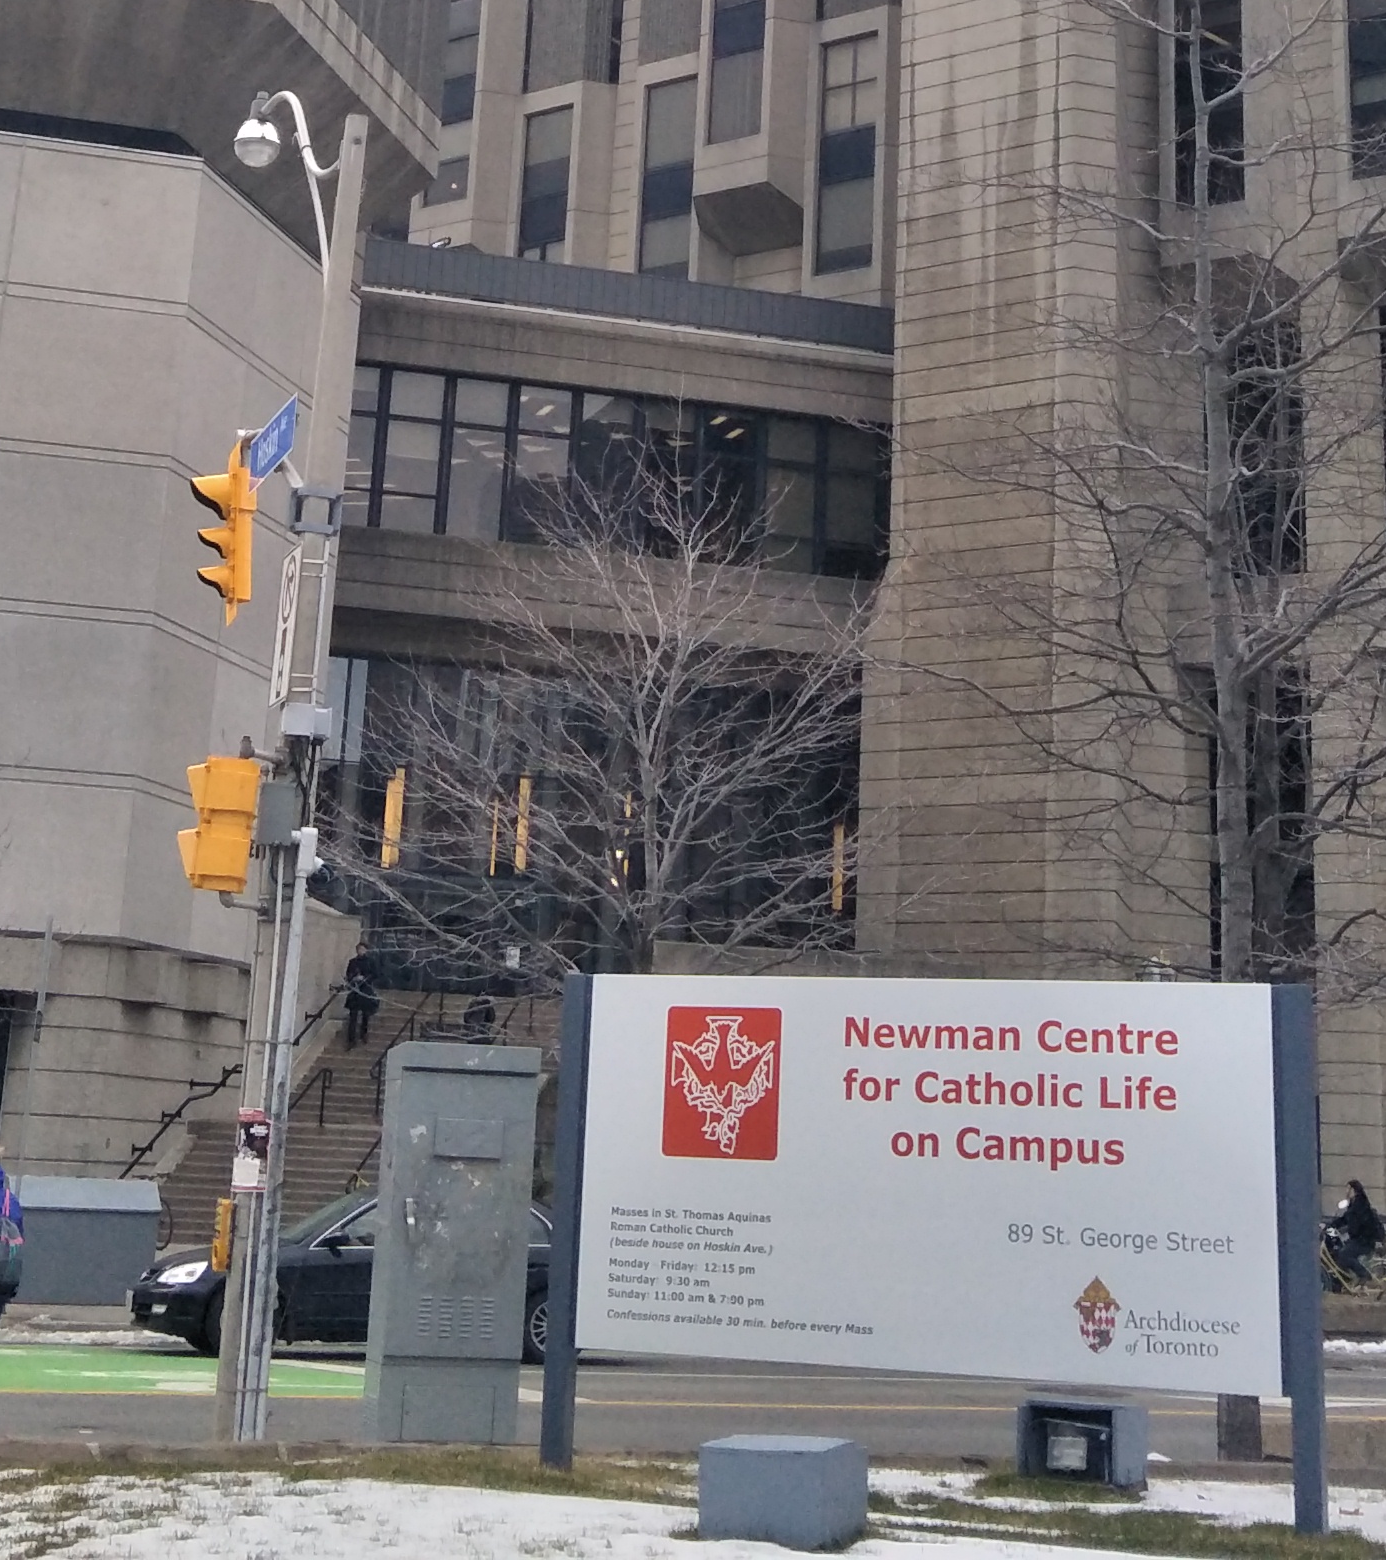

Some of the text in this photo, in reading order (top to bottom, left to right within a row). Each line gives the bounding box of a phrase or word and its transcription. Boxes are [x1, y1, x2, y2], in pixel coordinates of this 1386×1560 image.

[844, 1016, 1179, 1056] Newman Centre
[843, 1068, 1178, 1111] for Catholic Life
[891, 1127, 1126, 1171] on Campus
[611, 1206, 649, 1218] Masses
[652, 1208, 662, 1218] in
[682, 1209, 725, 1221] Thomas
[727, 1211, 772, 1223] Aquinas
[610, 1221, 734, 1237] Roman Catholic Church
[1007, 1223, 1235, 1254] 89 St. George Street
[609, 1236, 774, 1256] (beside house on Hoskin Ave.)
[608, 1257, 650, 1271] Monday
[704, 1262, 735, 1274] 12:15
[738, 1265, 756, 1276] pm
[665, 1275, 691, 1287] 9:30
[693, 1278, 710, 1287] am
[607, 1288, 765, 1308] Sunday: 11:00 am & 7:00 pm
[606, 1308, 874, 1335] Confessions available 30 min. before every Mass
[1124, 1309, 1241, 1334] Archdiocese
[1125, 1333, 1219, 1357] of Toronto
